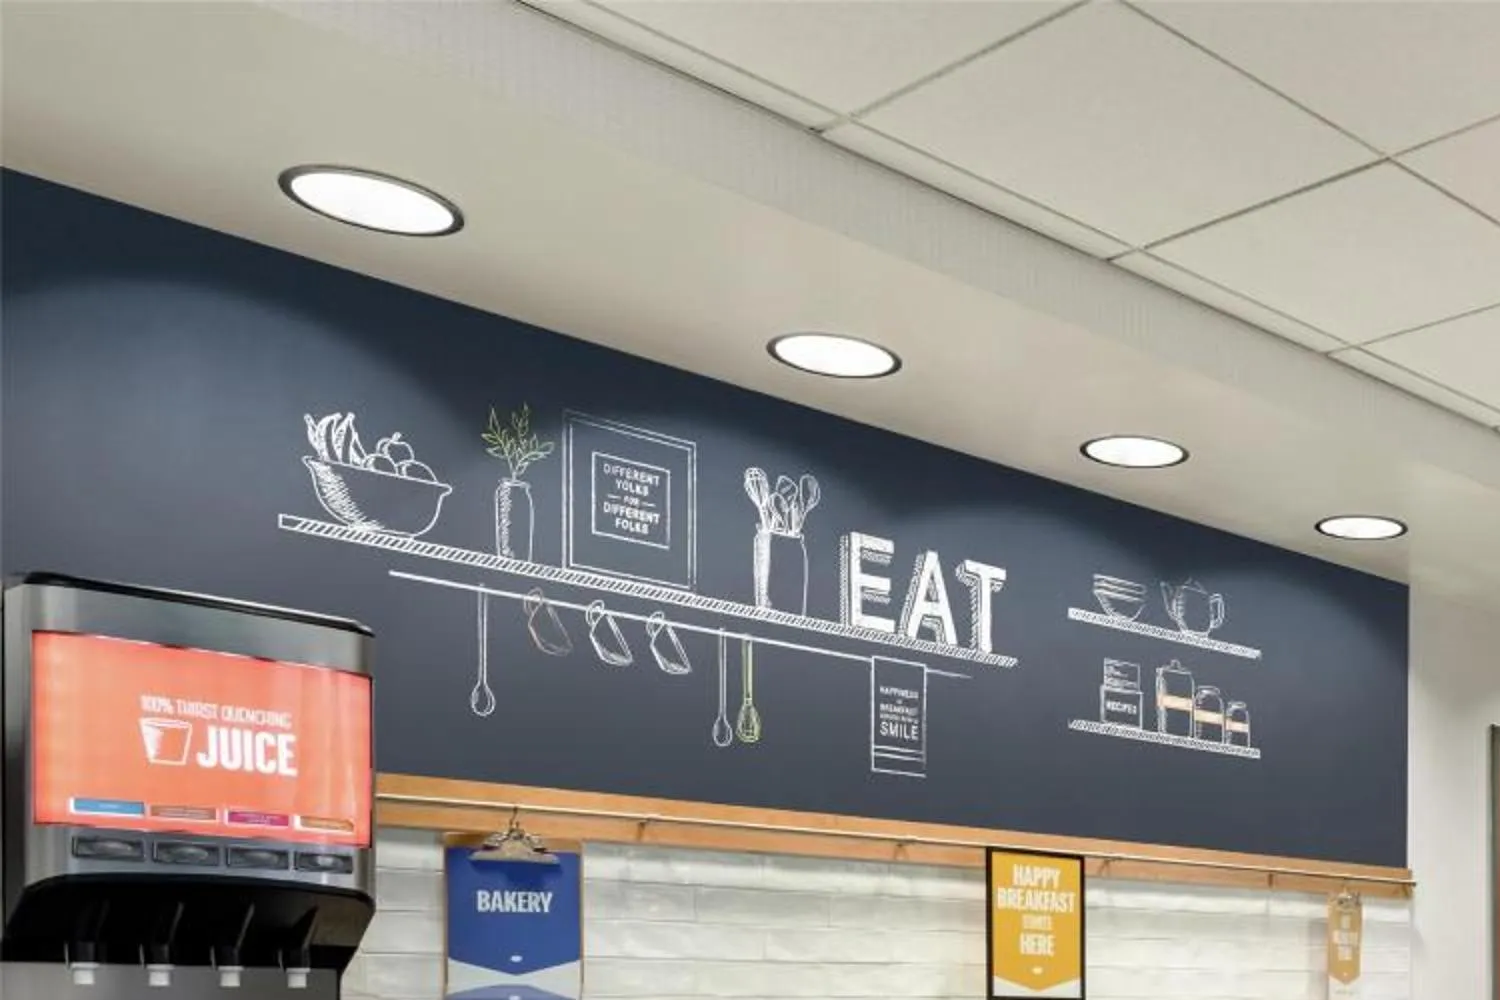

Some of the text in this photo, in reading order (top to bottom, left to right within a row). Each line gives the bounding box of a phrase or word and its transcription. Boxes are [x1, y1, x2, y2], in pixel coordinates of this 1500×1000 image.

[603, 463, 660, 487] DIFFERENT
[615, 478, 649, 497] YOLKS
[603, 501, 660, 524] DIFFERENT
[615, 517, 649, 535] FOLKS
[840, 531, 1007, 653] EAT
[879, 721, 919, 741] SMILE
[196, 725, 298, 777] JUICE
[1013, 863, 1061, 889] HAPPY
[476, 890, 553, 913] BAKERY
[997, 887, 1075, 913] BREAKFAST
[1020, 932, 1055, 957] HERE
